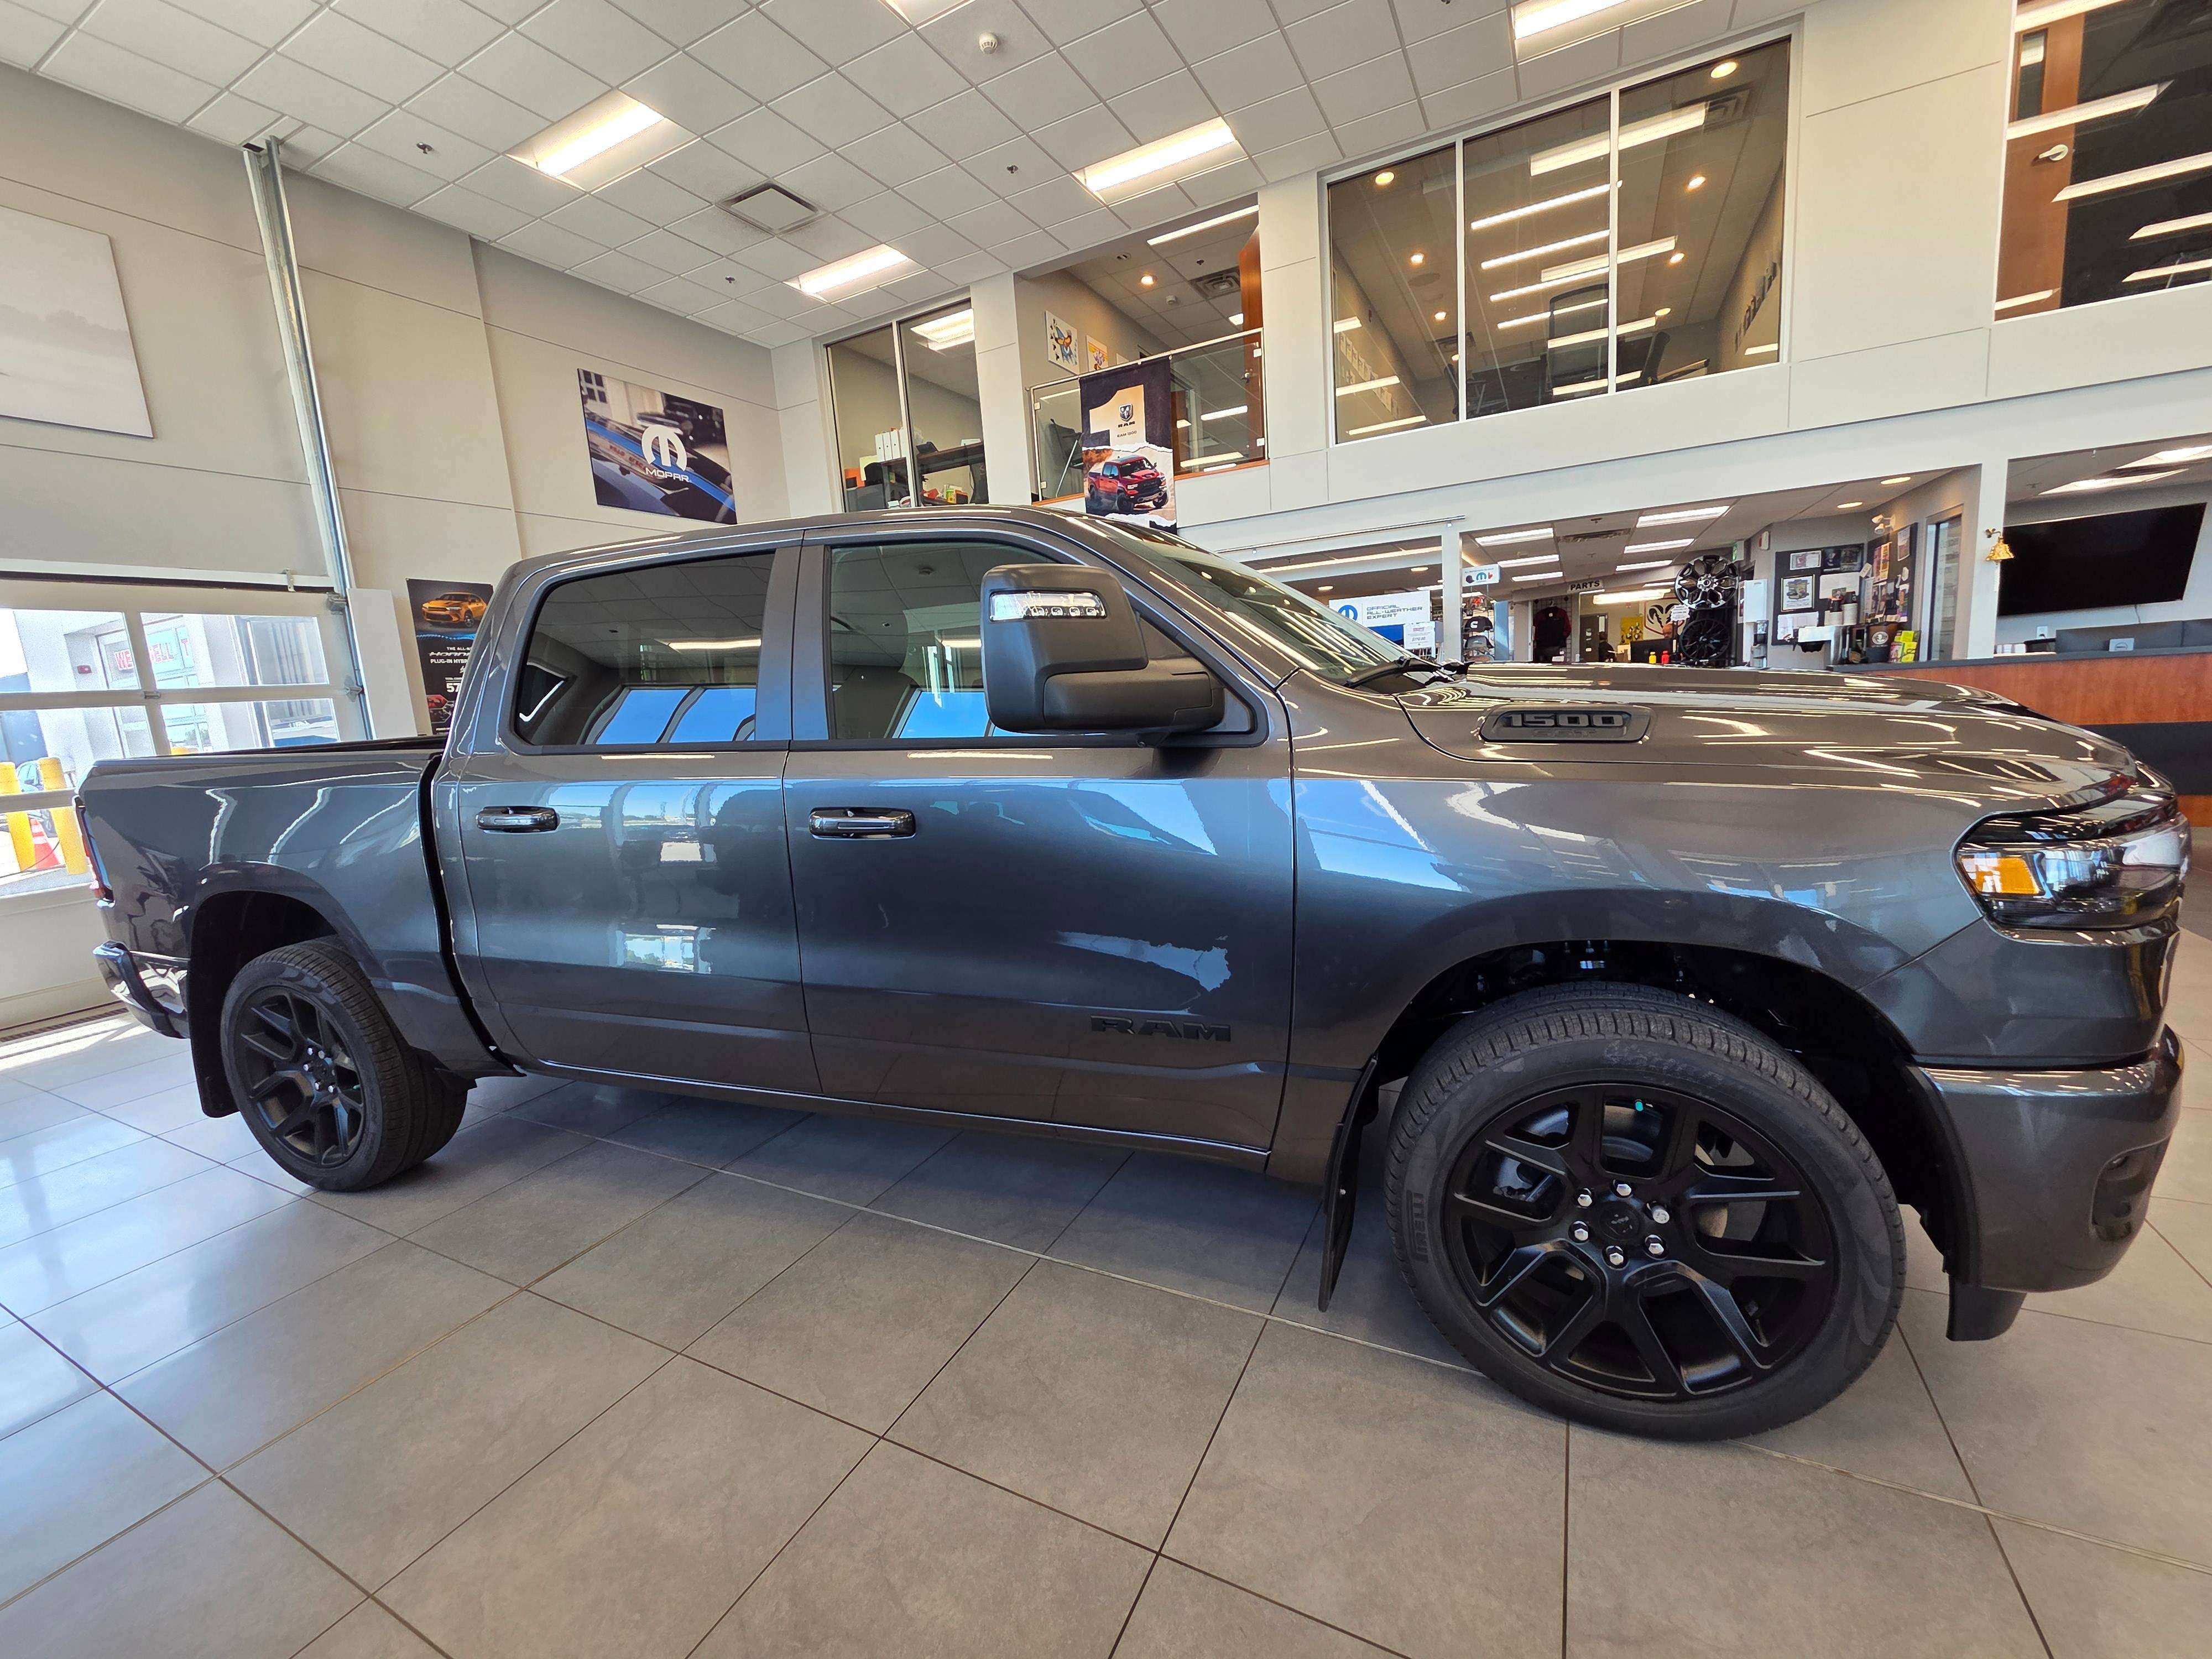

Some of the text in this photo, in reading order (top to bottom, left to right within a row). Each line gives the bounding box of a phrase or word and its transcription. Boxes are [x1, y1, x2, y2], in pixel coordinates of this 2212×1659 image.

[645, 467, 690, 482] MOPAR
[1571, 580, 1600, 591] PARTS
[1503, 713, 1624, 727] 1500
[1090, 1015, 1232, 1042] RAM
